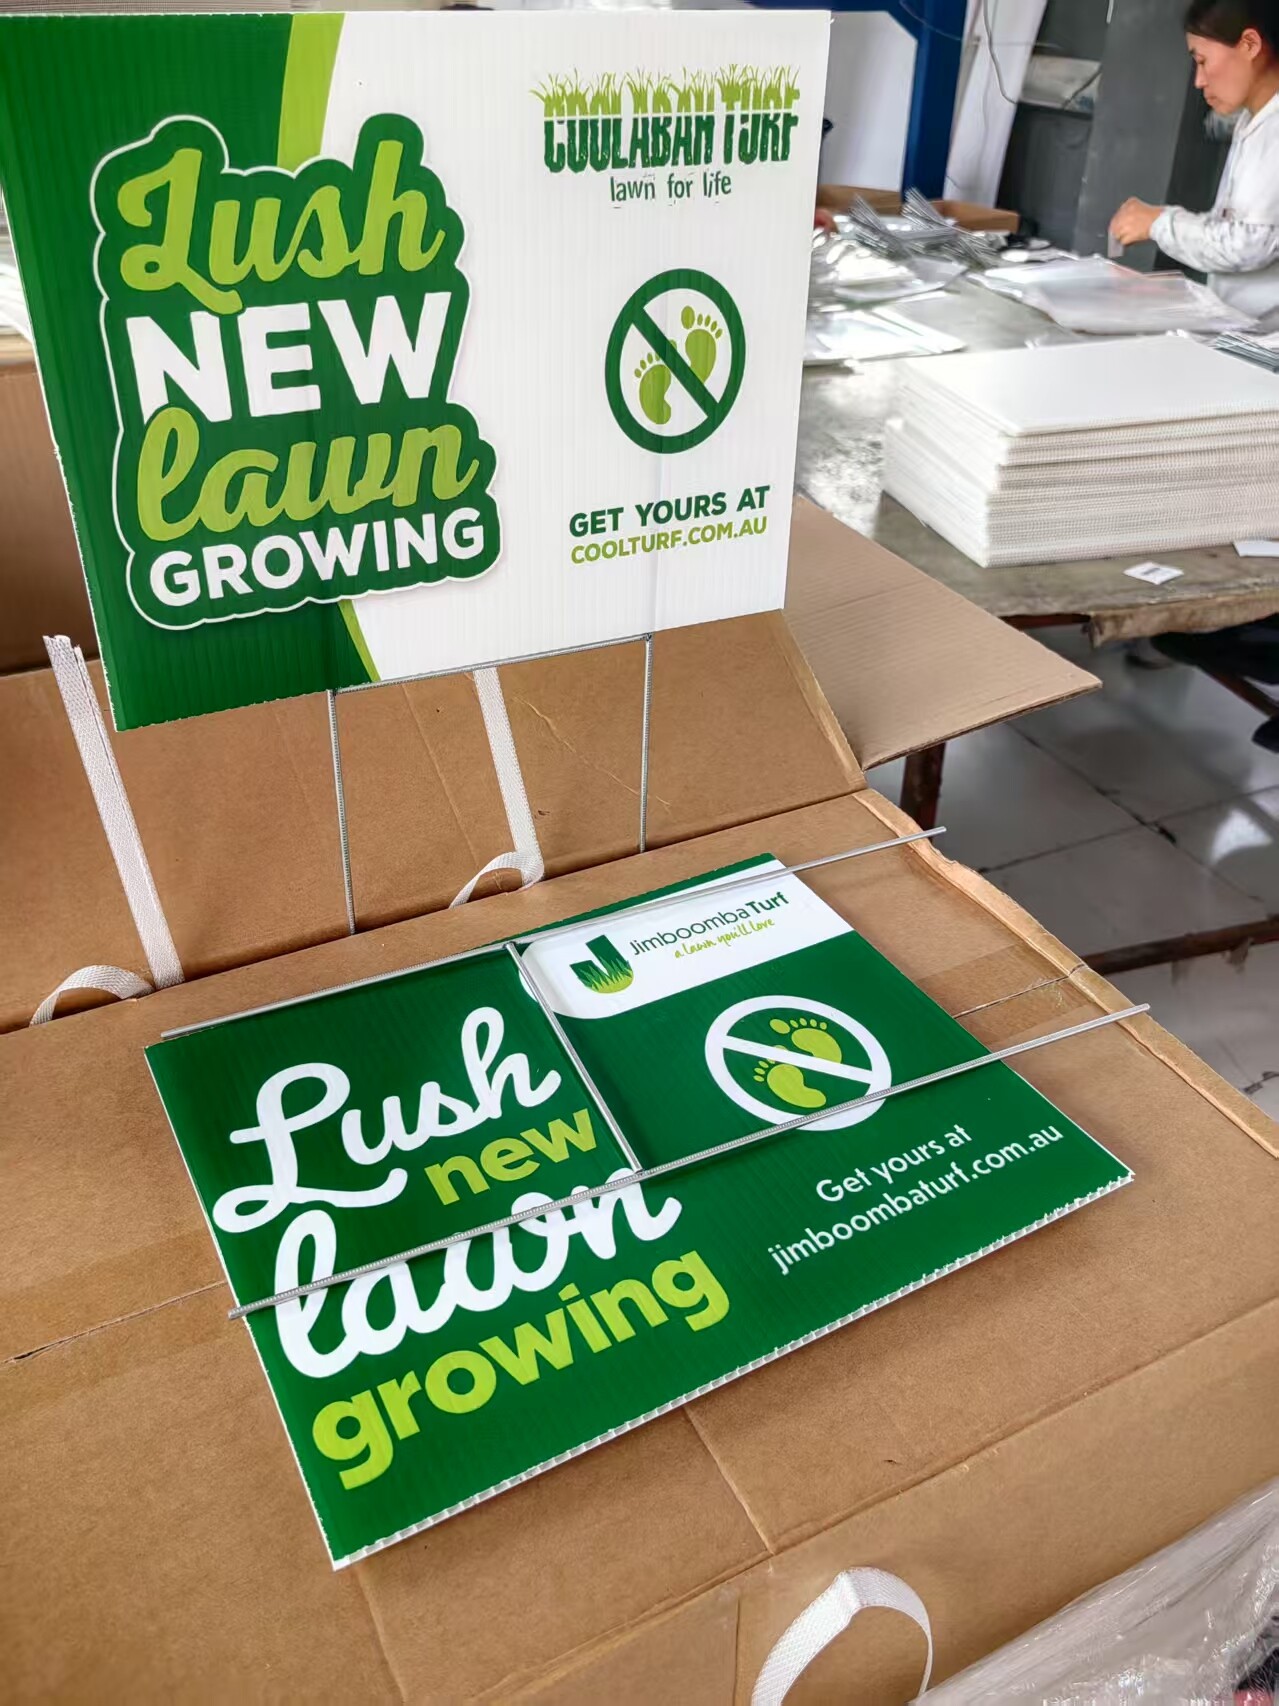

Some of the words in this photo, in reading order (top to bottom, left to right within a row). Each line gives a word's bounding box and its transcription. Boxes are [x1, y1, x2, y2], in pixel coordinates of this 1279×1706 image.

[718, 68, 800, 165] TURF
[117, 140, 446, 315] Lush
[609, 175, 656, 202] lawn
[667, 172, 694, 200] for
[703, 171, 732, 198] life
[126, 291, 452, 424] NEW
[137, 406, 480, 541] lawn
[569, 506, 624, 538] GET
[635, 491, 727, 527] YOURS
[736, 485, 770, 512] AT
[149, 507, 485, 607] GROWING
[570, 516, 768, 565] COOLTURF.COM.AU
[569, 934, 635, 994] J
[629, 891, 790, 956] JimboombaTurf
[674, 948, 684, 959] a
[681, 937, 717, 955] lawn
[748, 918, 776, 933] love
[212, 1006, 562, 1233] Lush
[424, 1108, 597, 1206] new
[816, 1167, 873, 1203] Get
[869, 1139, 946, 1185] yours
[944, 1124, 973, 1149] at
[767, 1124, 1065, 1276] jimboombaturf.com.au
[273, 1167, 683, 1379] lawn
[311, 1250, 731, 1491] growing
